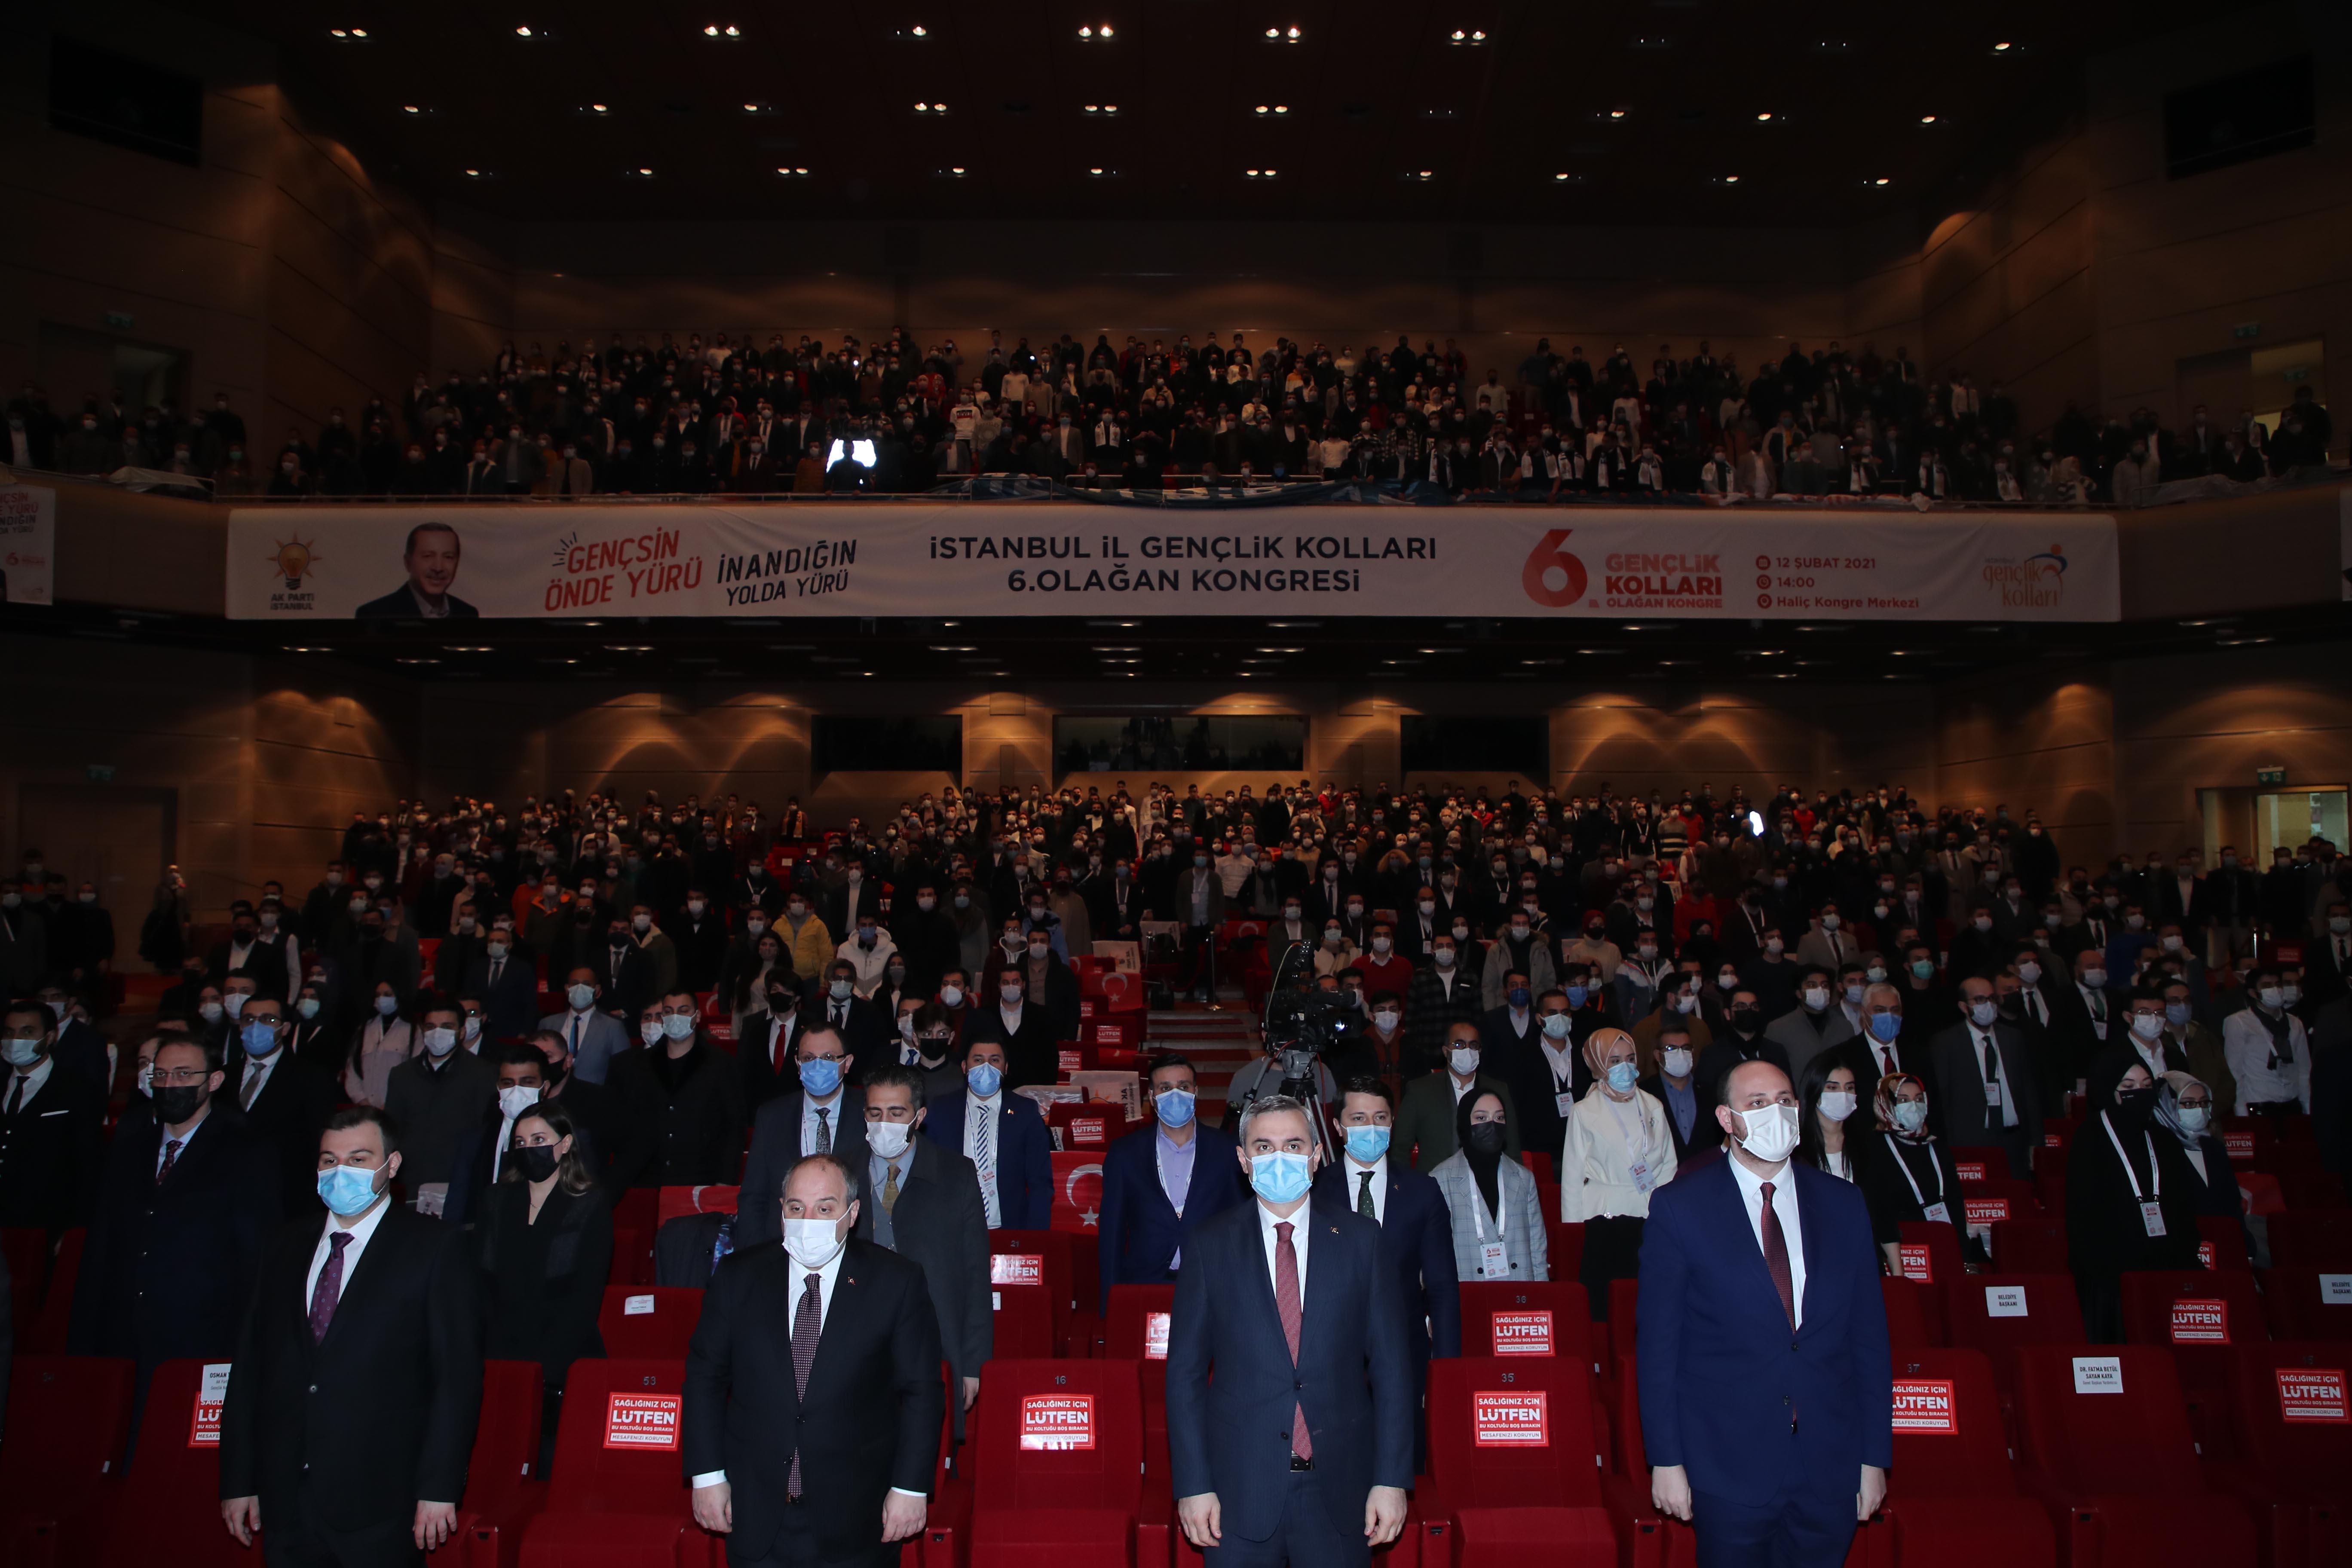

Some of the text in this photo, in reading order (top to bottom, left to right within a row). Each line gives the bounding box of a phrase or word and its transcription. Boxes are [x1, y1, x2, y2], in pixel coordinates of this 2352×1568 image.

[567, 527, 680, 573] GENÇSİN
[1296, 536, 1436, 559] KOLLARI
[717, 539, 857, 584] İNANDIĞIN
[1605, 553, 1721, 576] GENÇLİK
[1776, 557, 1876, 570] 12 ŞUBAT 2021
[1008, 563, 1179, 591] 6.OLAĞAN
[1777, 577, 1815, 588] 14:00
[545, 557, 703, 611] ÖNDE YÜRÜ
[726, 570, 848, 606] YOLDA YÜRÜ
[1606, 576, 1722, 596] KOLLARI
[288, 593, 314, 601] PARTİ
[1607, 596, 1722, 608] OLAĞAN KONGRE
[1777, 596, 1919, 609] Haliç Kongre Merkezi
[271, 602, 313, 610] İSTANBUL
[1966, 1209, 2006, 1218] LÜTFEN
[2172, 1313, 2221, 1323] LÜTFEN
[1496, 1325, 1548, 1336] LÜTFEN
[1907, 1363, 1920, 1373] 37
[643, 1376, 656, 1386] 53
[1055, 1375, 1066, 1385] 16
[1501, 1373, 1514, 1382] 35
[2282, 1385, 2341, 1398] LÜTFEN
[614, 1399, 676, 1409] SAĞLIĞINIZ İÇİN
[1027, 1400, 1071, 1409] SAĞLIĞINIZ
[612, 1409, 675, 1425] LÜTFEN
[1026, 1411, 1088, 1424] LÜTFEN
[1478, 1408, 1540, 1421] LÜTFEN
